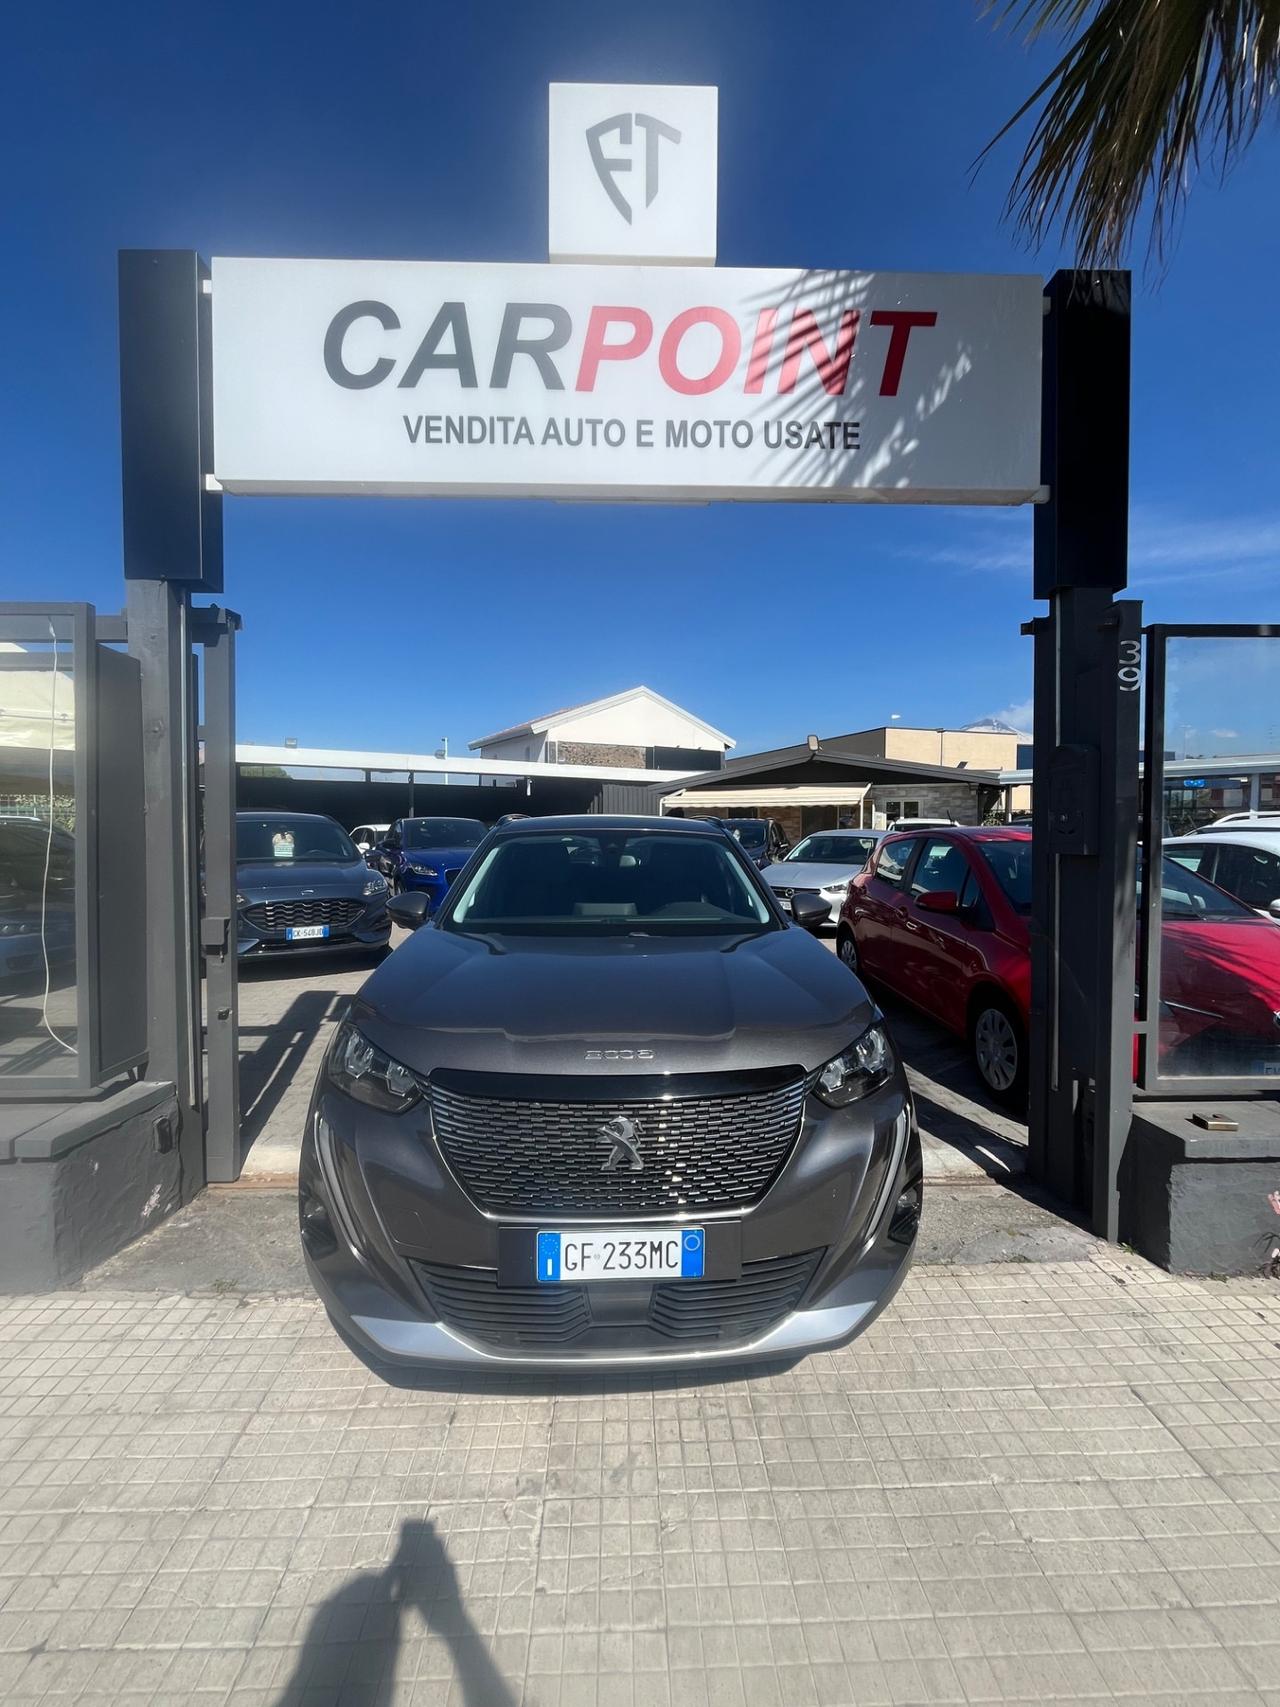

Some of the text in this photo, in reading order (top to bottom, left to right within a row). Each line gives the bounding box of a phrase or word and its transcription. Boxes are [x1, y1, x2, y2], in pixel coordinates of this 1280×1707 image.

[322, 299, 938, 398] CARPOINT
[402, 414, 861, 451] VENDITA AUTO E MOTO USATE
